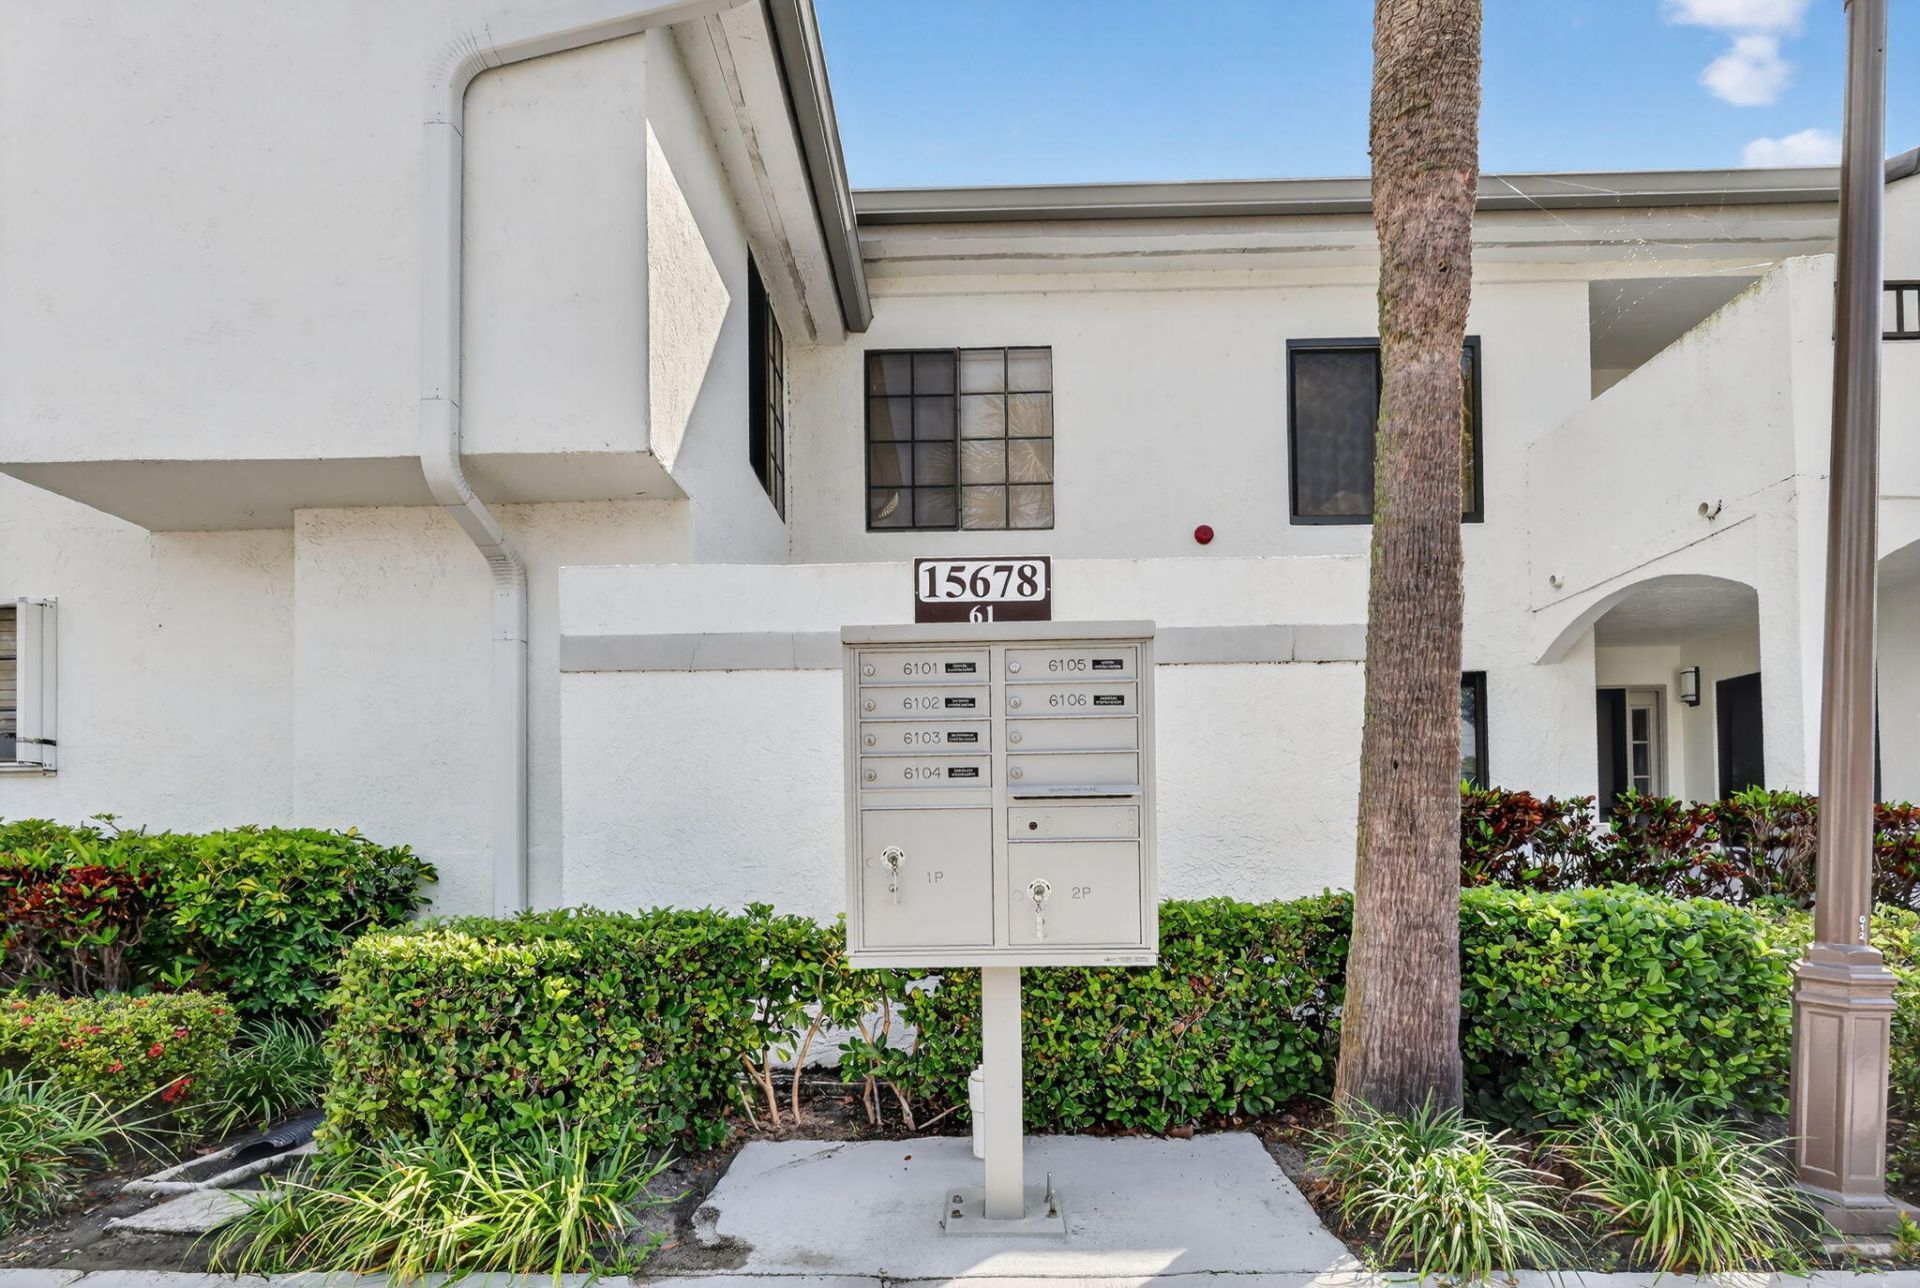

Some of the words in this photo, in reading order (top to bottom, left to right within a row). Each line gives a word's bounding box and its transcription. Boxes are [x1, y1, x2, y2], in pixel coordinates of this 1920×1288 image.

[923, 564, 1039, 598] 15678
[969, 604, 994, 624] 61
[903, 662, 938, 676] 6101
[1048, 658, 1087, 672] 6105
[903, 696, 941, 710] 6102
[1048, 693, 1087, 707] 6106
[903, 731, 941, 745] 6103
[903, 766, 941, 780] 6104
[926, 871, 944, 884] 1P
[1071, 886, 1092, 900] 2P
